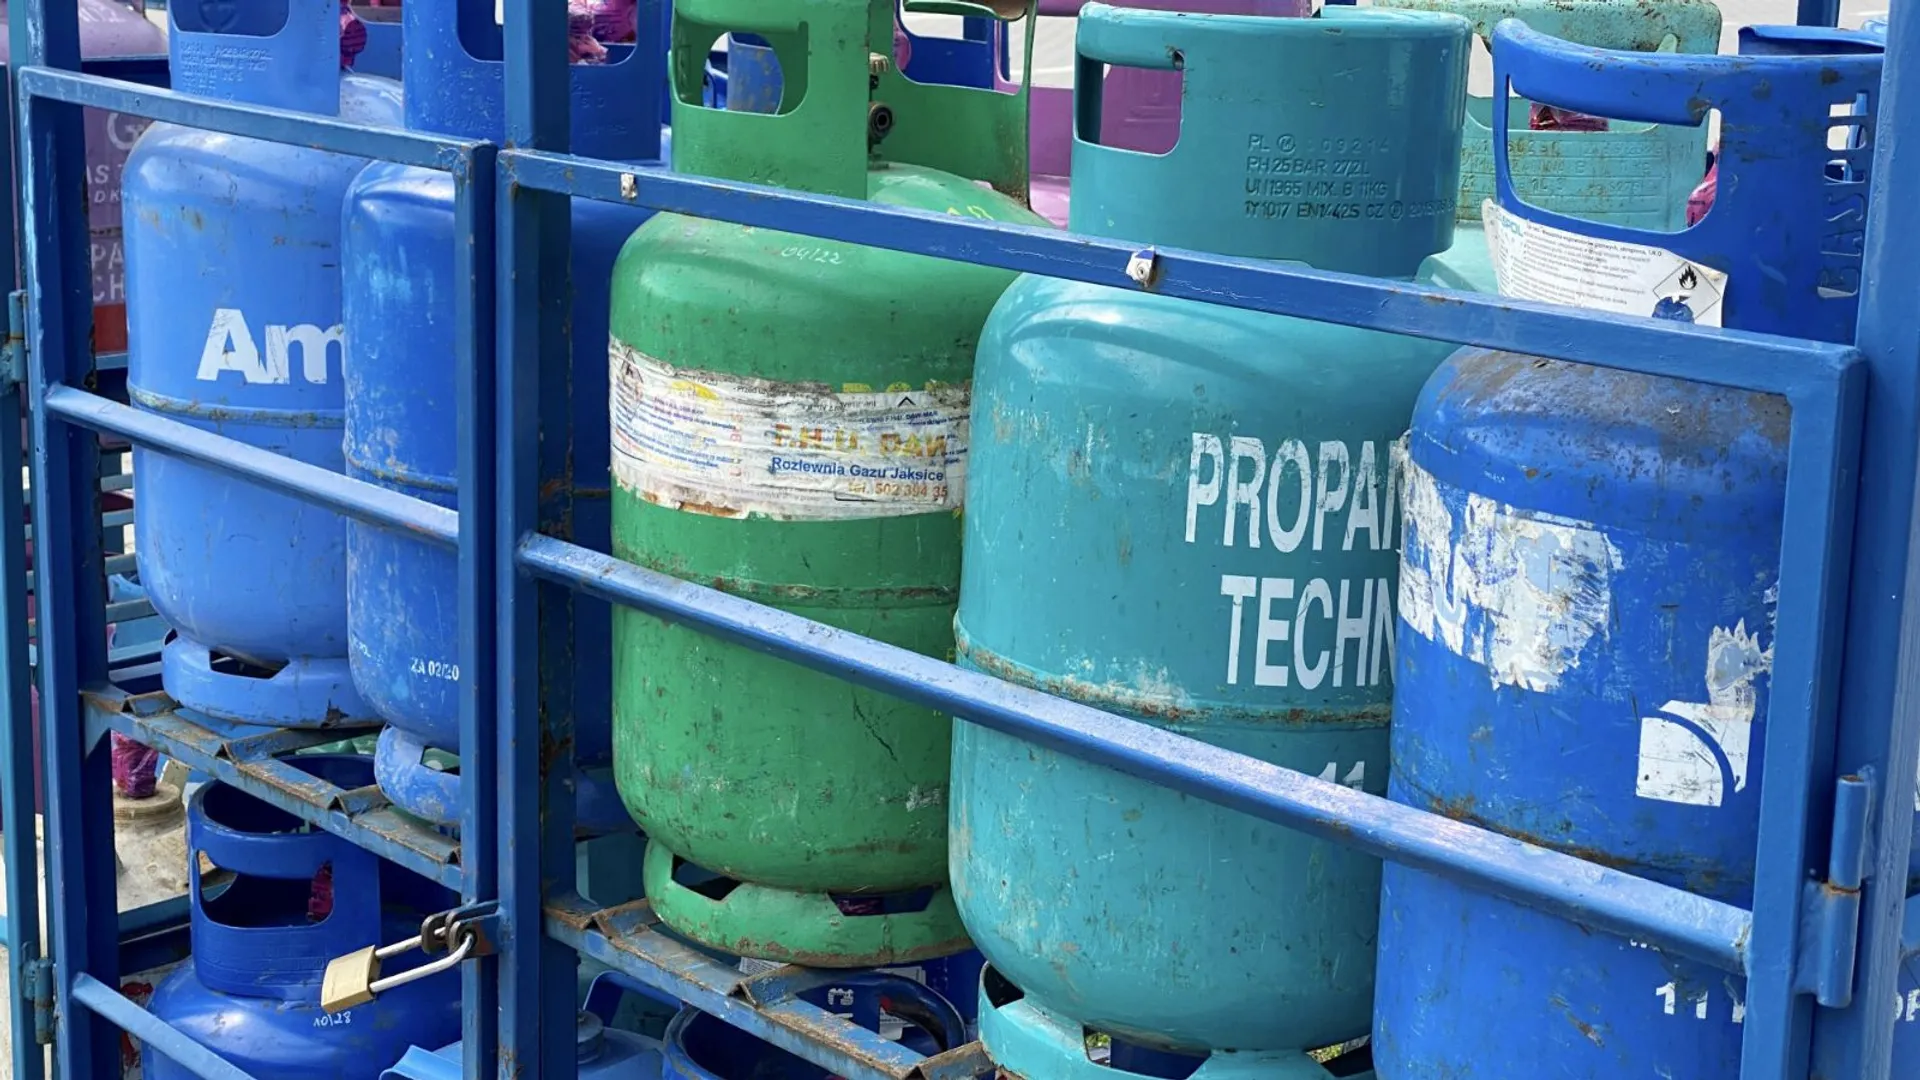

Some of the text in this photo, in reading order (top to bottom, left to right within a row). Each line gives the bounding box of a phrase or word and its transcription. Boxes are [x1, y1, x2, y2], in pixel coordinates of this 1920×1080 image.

[771, 457, 944, 481] Rozlewnia Gazu Jaksice
[875, 482, 899, 496] 502
[903, 483, 927, 497] 394
